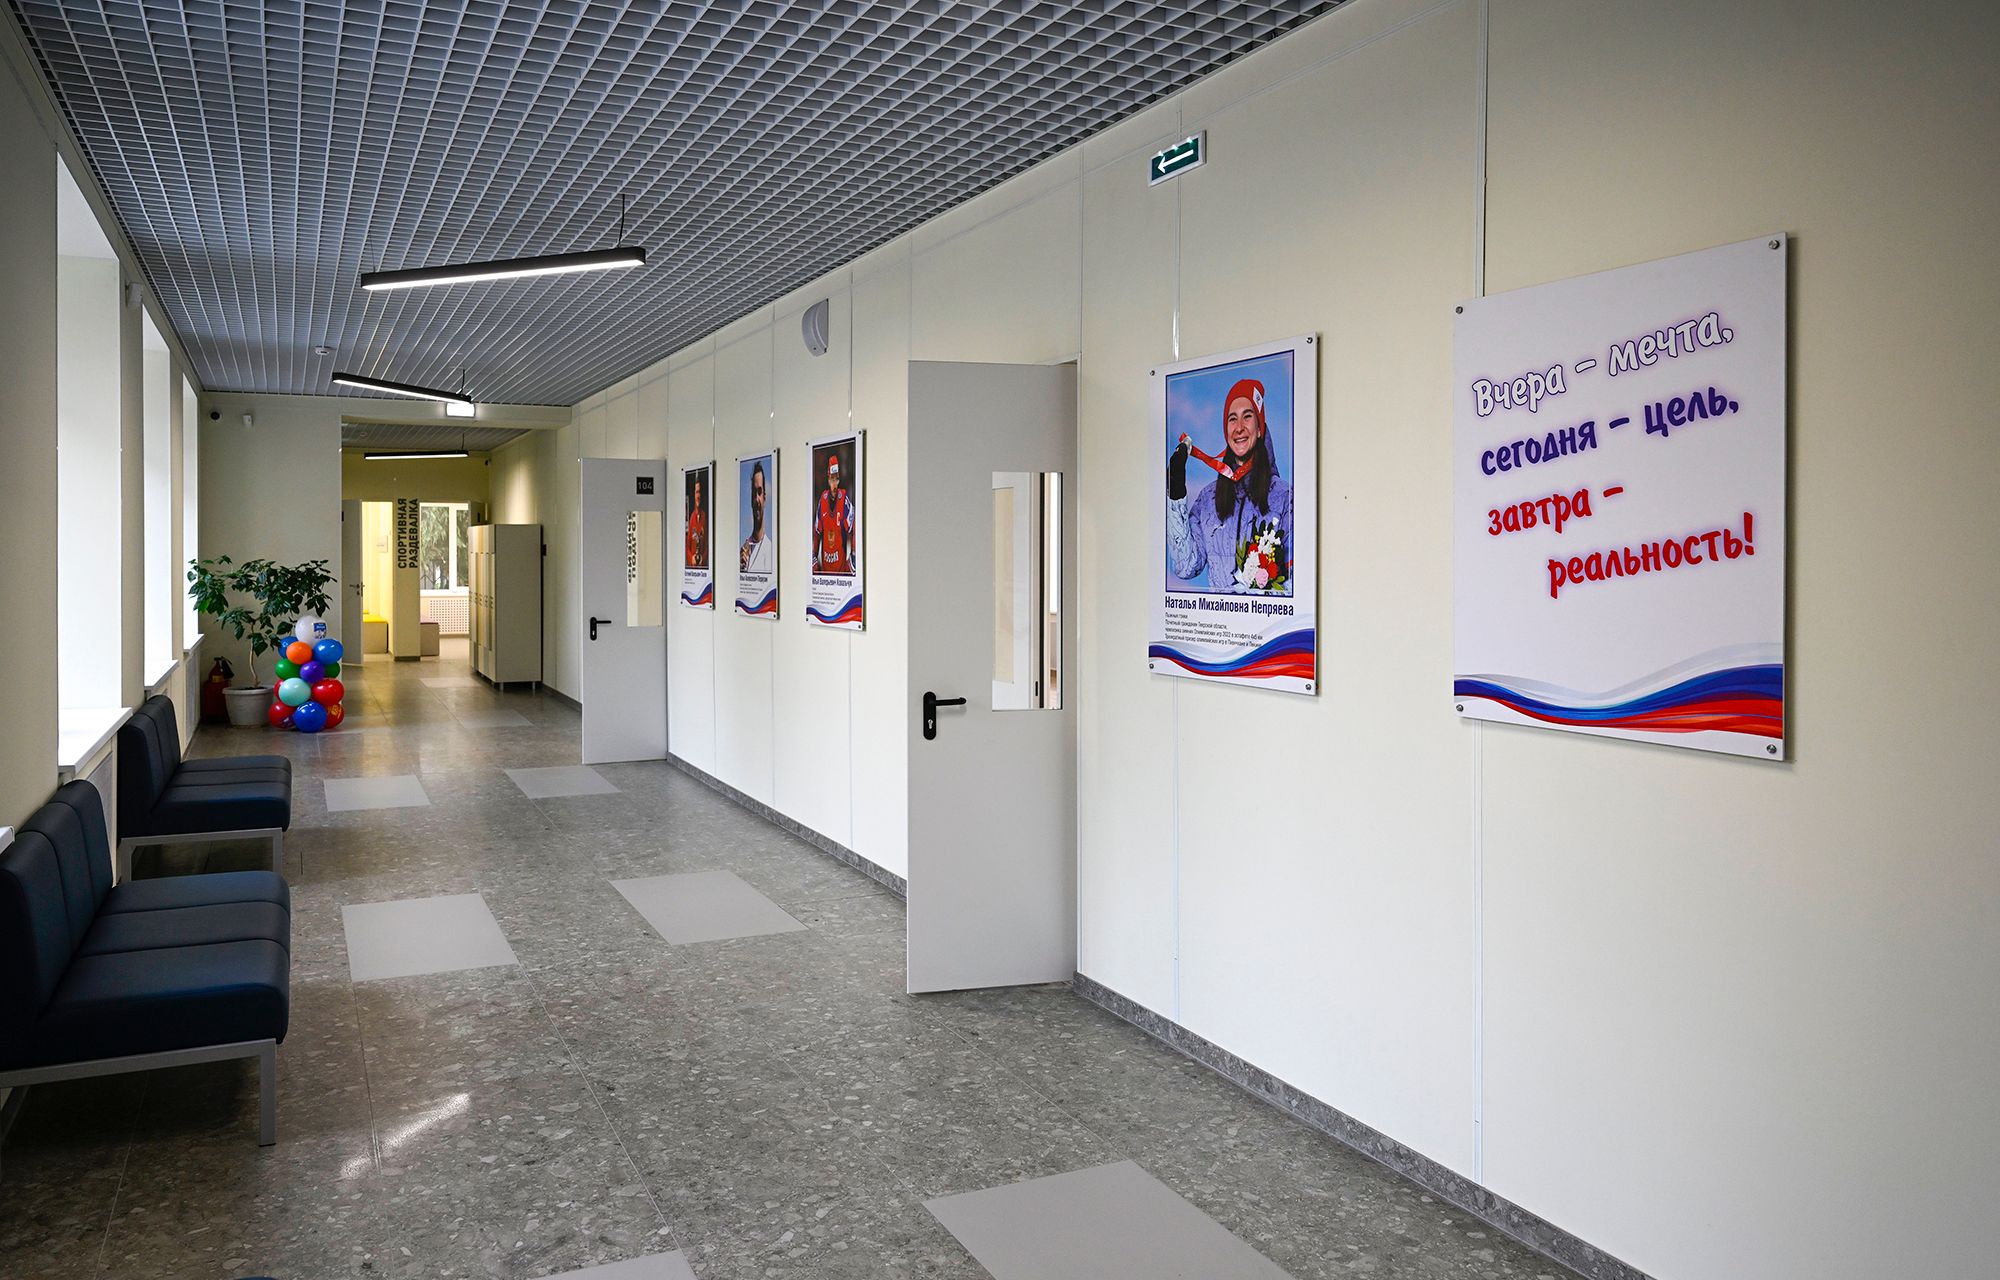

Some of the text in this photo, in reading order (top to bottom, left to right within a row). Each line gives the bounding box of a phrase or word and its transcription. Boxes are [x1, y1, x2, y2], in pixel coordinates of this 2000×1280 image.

[1472, 364, 1566, 417] Вчера
[1608, 312, 1734, 377] мечта,
[1481, 420, 1598, 475] сегодня
[1644, 386, 1740, 437] цель,
[637, 482, 652, 490] 104
[1487, 489, 1592, 536] завтра
[398, 498, 407, 569] СПОРТИВНАЯ
[409, 498, 420, 569] РАЗДЕВАЛКА
[1547, 511, 1755, 599] реальность!
[1165, 596, 1294, 617] Наталья Михайловна Непряева
